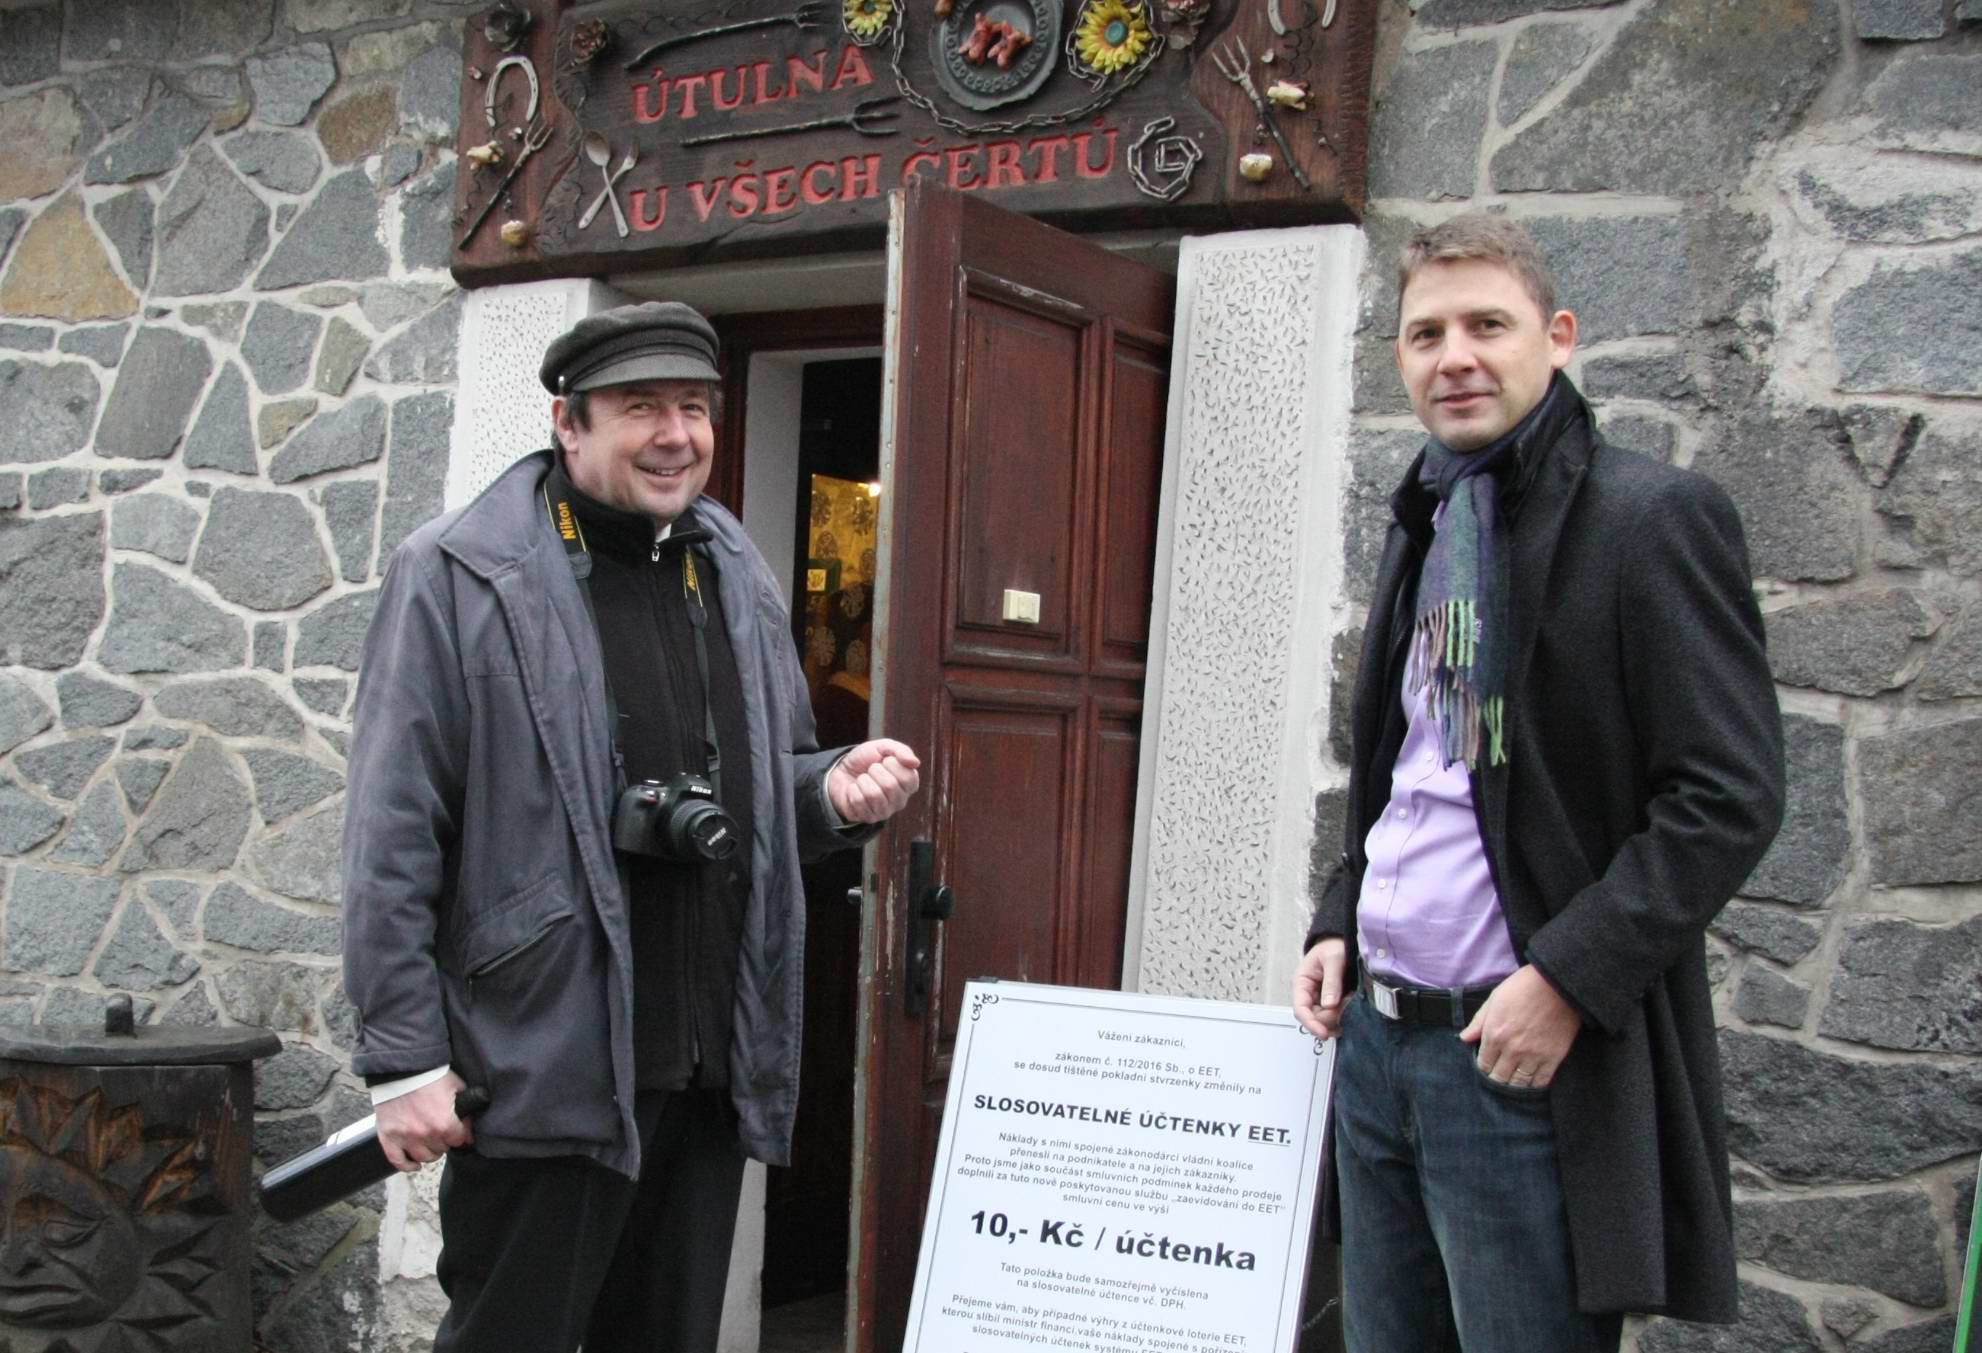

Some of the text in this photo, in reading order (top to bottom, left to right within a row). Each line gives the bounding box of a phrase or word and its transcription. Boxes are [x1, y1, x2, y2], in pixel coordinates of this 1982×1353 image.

[632, 46, 875, 124] ÚTULNA
[629, 186, 669, 231] U
[686, 153, 882, 222] VŠECH
[558, 501, 577, 540] Nikon
[1014, 1061, 1026, 1069] se
[1028, 1061, 1061, 1073] dosud
[1064, 1065, 1098, 1077] tištěné
[1150, 1075, 1201, 1090] stvrzenky
[1203, 1081, 1246, 1095] změnily
[1248, 1086, 1262, 1095] na
[1055, 1052, 1101, 1064] zákonem
[1118, 1058, 1162, 1071] 112/2016
[1188, 1067, 1195, 1075] o
[1198, 1065, 1221, 1078] EET,
[974, 1094, 1291, 1144] SLOSOVATELNÉ ÚČTENKY EET.
[998, 1132, 1039, 1147] Náklady
[1049, 1139, 1071, 1149] nimi
[1074, 1143, 1114, 1154] spojené
[1116, 1147, 1179, 1162] zákonodárci
[1216, 1158, 1253, 1171] koalice
[1009, 1147, 1050, 1159] přenesli
[1067, 1155, 1126, 1169] podnikatele
[1138, 1164, 1150, 1172] na
[1152, 1164, 1181, 1176] jejich
[957, 1166, 994, 1179] doplnili
[996, 1172, 1008, 1181] za
[1010, 1173, 1030, 1183] tuto
[1059, 1180, 1131, 1196] poskytovanou
[1135, 1189, 1168, 1201] službu
[1241, 1202, 1255, 1211] do
[964, 1153, 991, 1165] Proto
[992, 1159, 1017, 1168] jsme
[1019, 1161, 1041, 1171] jako
[1044, 1165, 1083, 1176] součást
[1195, 1182, 1239, 1196] každého
[1242, 1190, 1282, 1203] prodeje
[1105, 1199, 1130, 1209] cenu
[1133, 1203, 1145, 1211] ve
[971, 1210, 1256, 1271] 10,- Kč / účtenka
[1001, 1262, 1021, 1274] Tato
[1023, 1268, 1063, 1280] položka
[1066, 1272, 1091, 1284] bude
[1094, 1277, 1157, 1293] samozřejmě
[1017, 1279, 1029, 1287] na
[1032, 1280, 1096, 1297] slosovatelné
[942, 1306, 973, 1319] kterou
[1002, 1317, 1038, 1328] ministr
[1078, 1328, 1101, 1338] vaše
[1104, 1332, 1145, 1346] náklady
[1147, 1338, 1189, 1351] spojené
[952, 1294, 992, 1309] Přejeme
[995, 1302, 1018, 1313] vám,
[1021, 1305, 1040, 1318] aby
[1121, 1321, 1128, 1329] z
[1187, 1328, 1221, 1342] loterie
[1223, 1333, 1246, 1347] EET,
